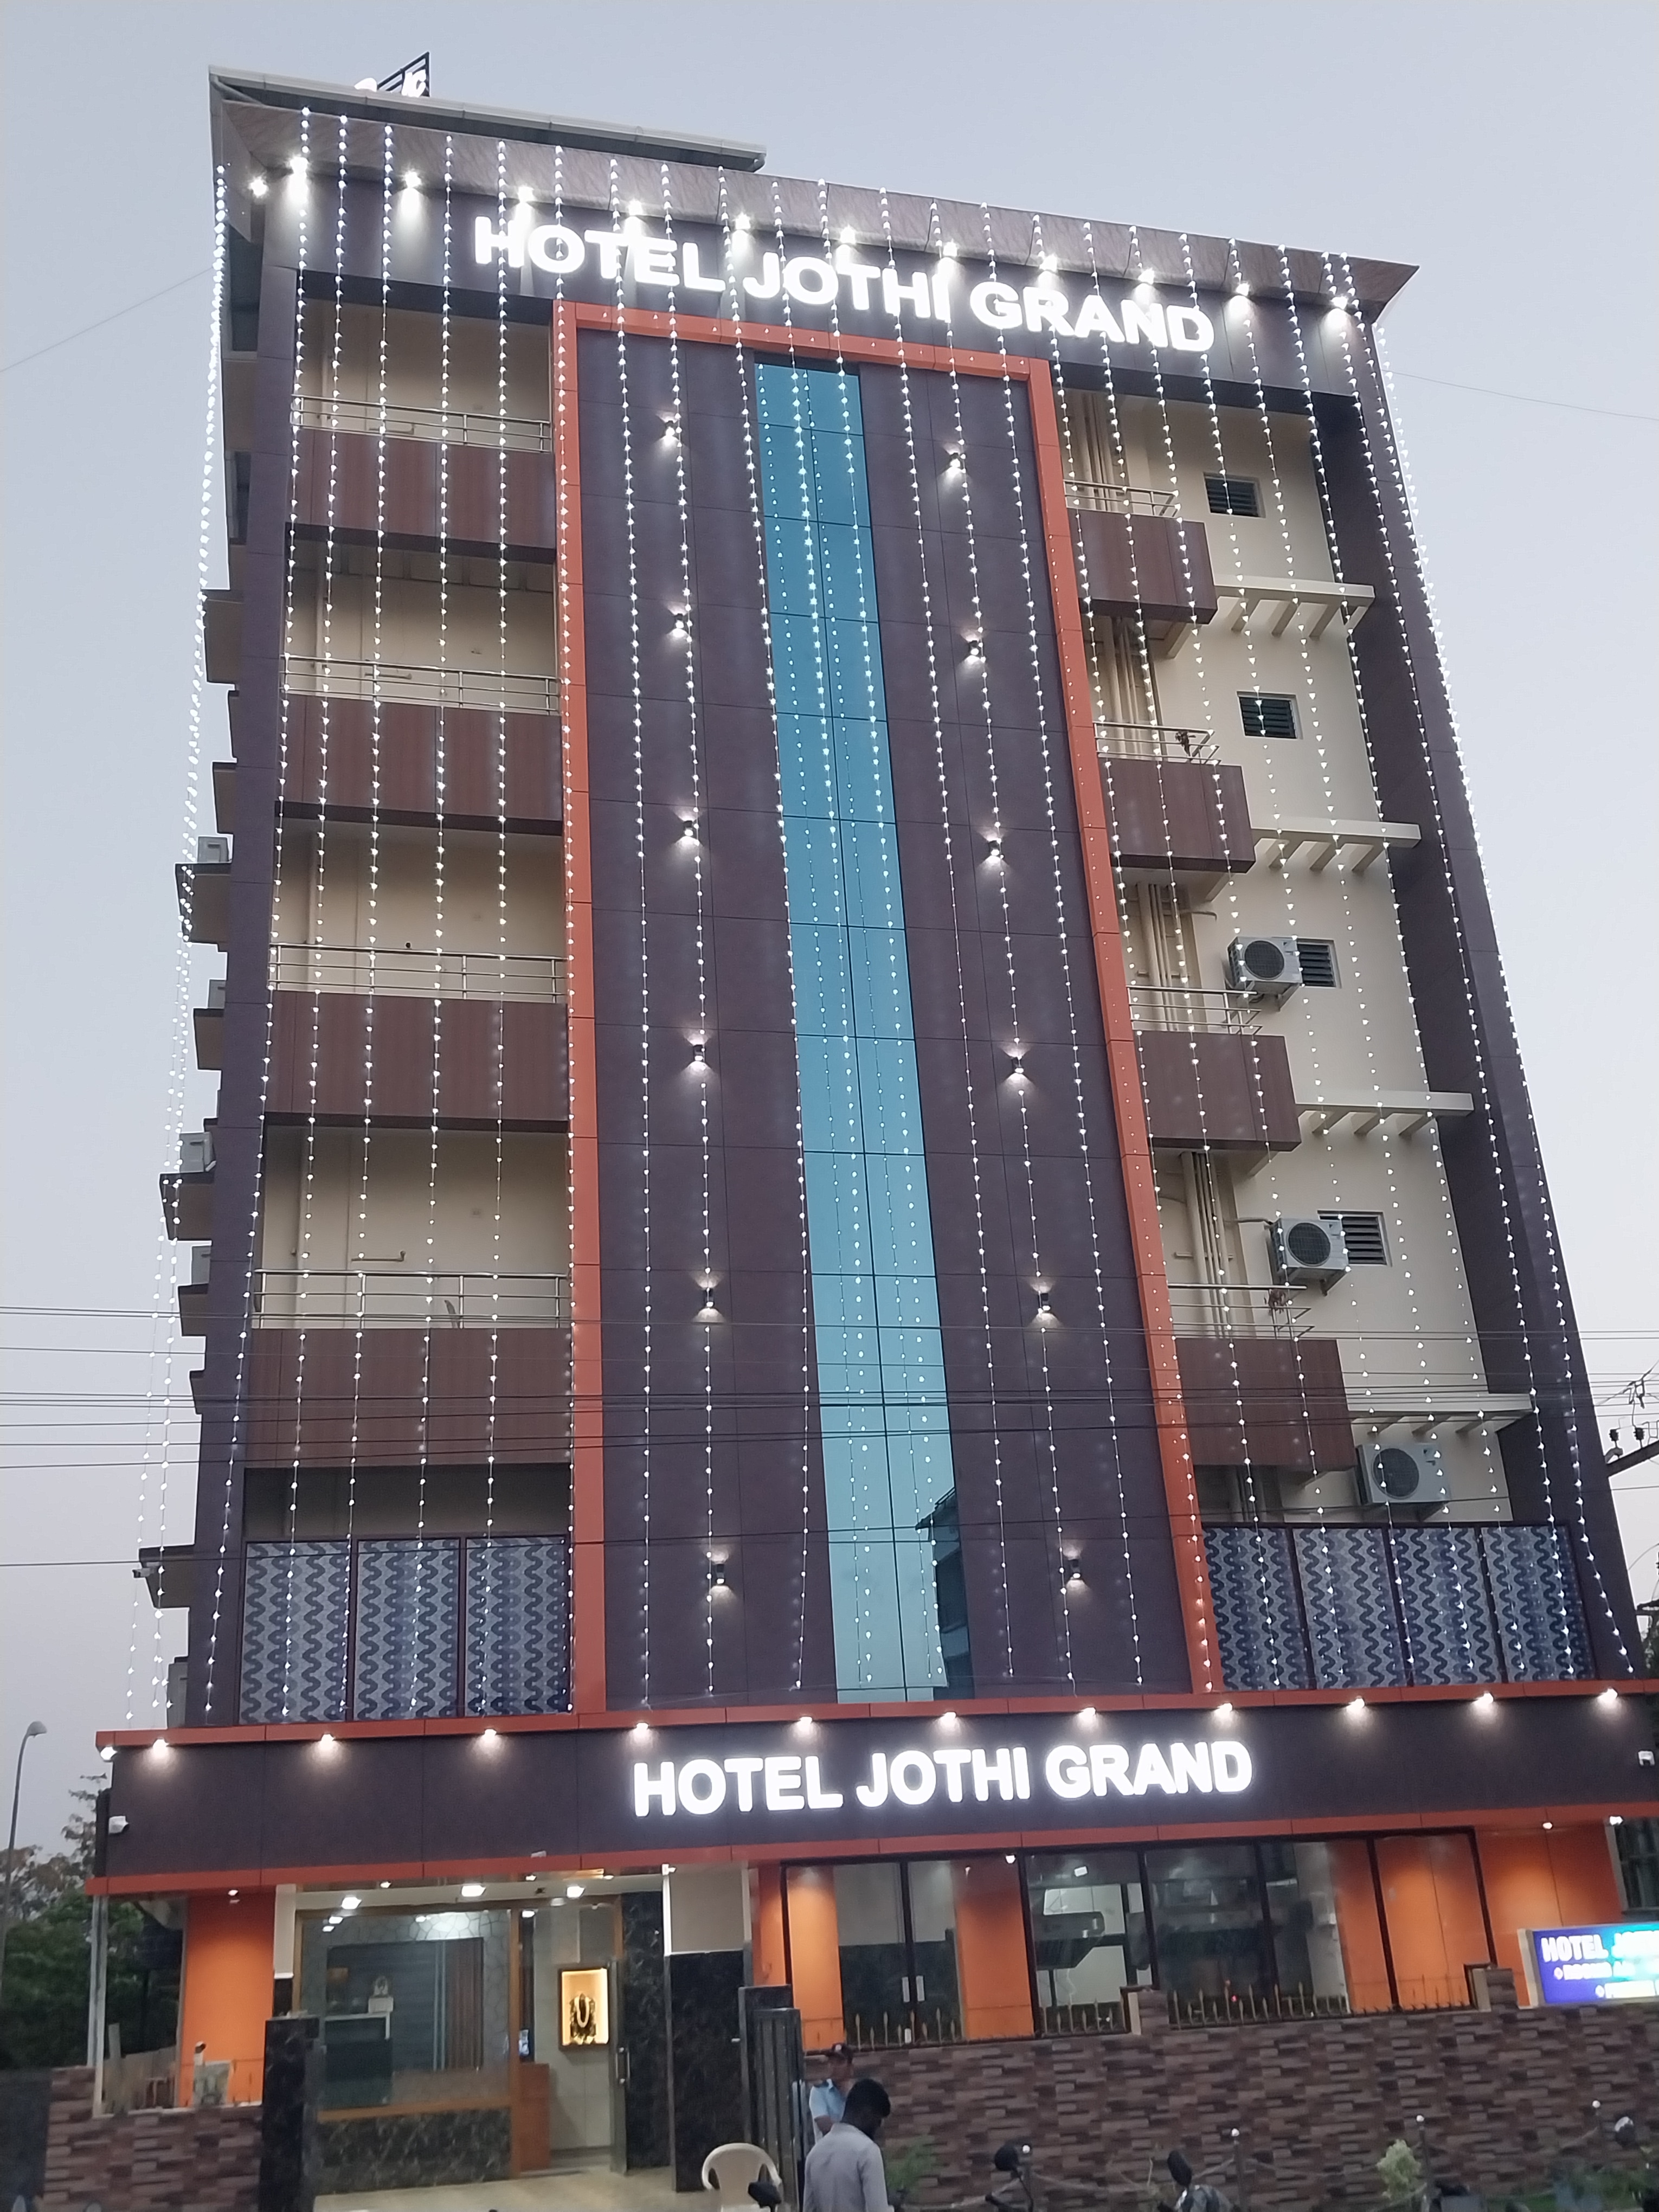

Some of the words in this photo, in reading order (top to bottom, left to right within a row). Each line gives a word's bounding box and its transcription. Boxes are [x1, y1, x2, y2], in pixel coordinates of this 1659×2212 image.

[475, 216, 726, 292] HOTEL
[743, 252, 951, 321] JOTHI
[970, 281, 1214, 351] GRAND
[634, 1756, 844, 1816] HOTEL
[856, 1747, 1030, 1807] JOTHI
[1045, 1741, 1252, 1798] GRAND
[1541, 1934, 1609, 1962] HOTEL
